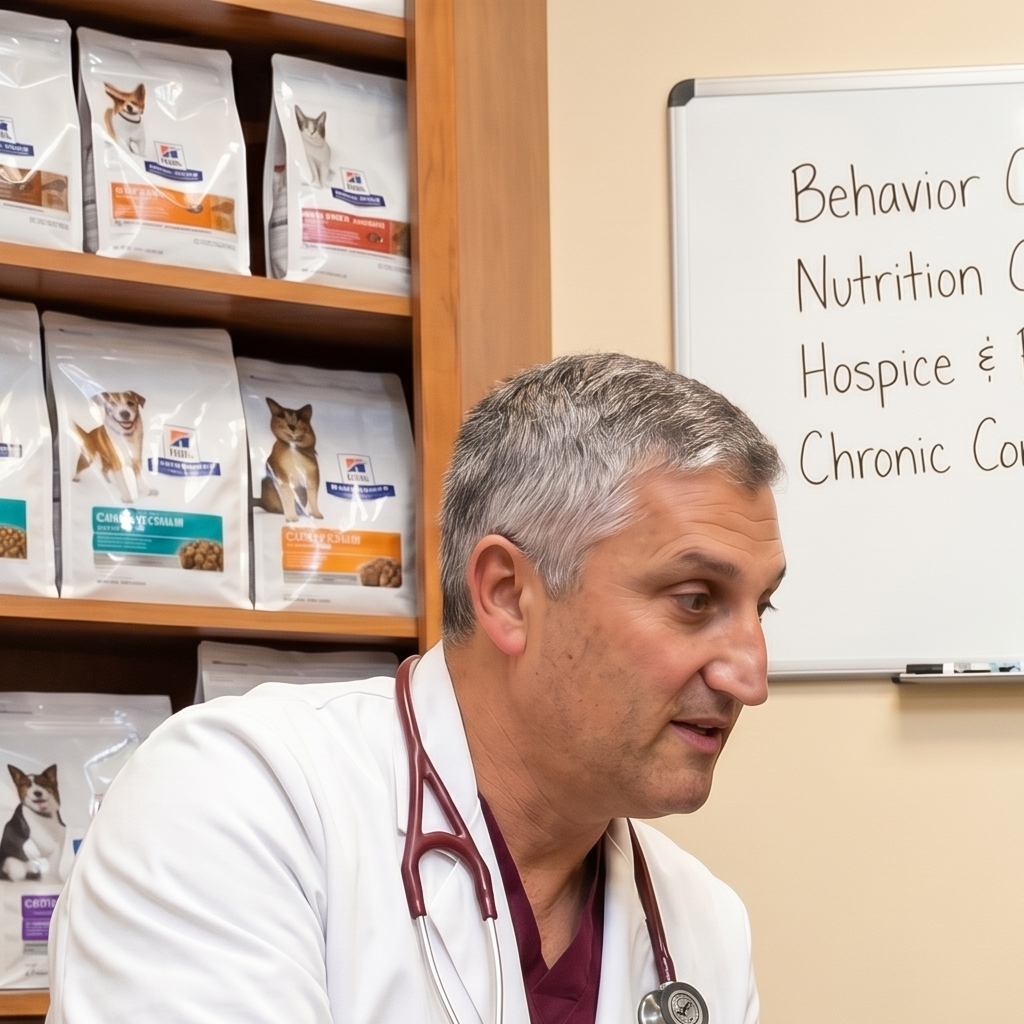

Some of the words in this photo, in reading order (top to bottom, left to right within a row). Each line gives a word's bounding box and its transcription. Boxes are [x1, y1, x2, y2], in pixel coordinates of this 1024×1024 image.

[792, 163, 980, 223] Behavior
[797, 251, 983, 313] Nutrition
[801, 342, 955, 408] Hospice
[979, 336, 996, 382] &
[800, 430, 951, 485] Chronic
